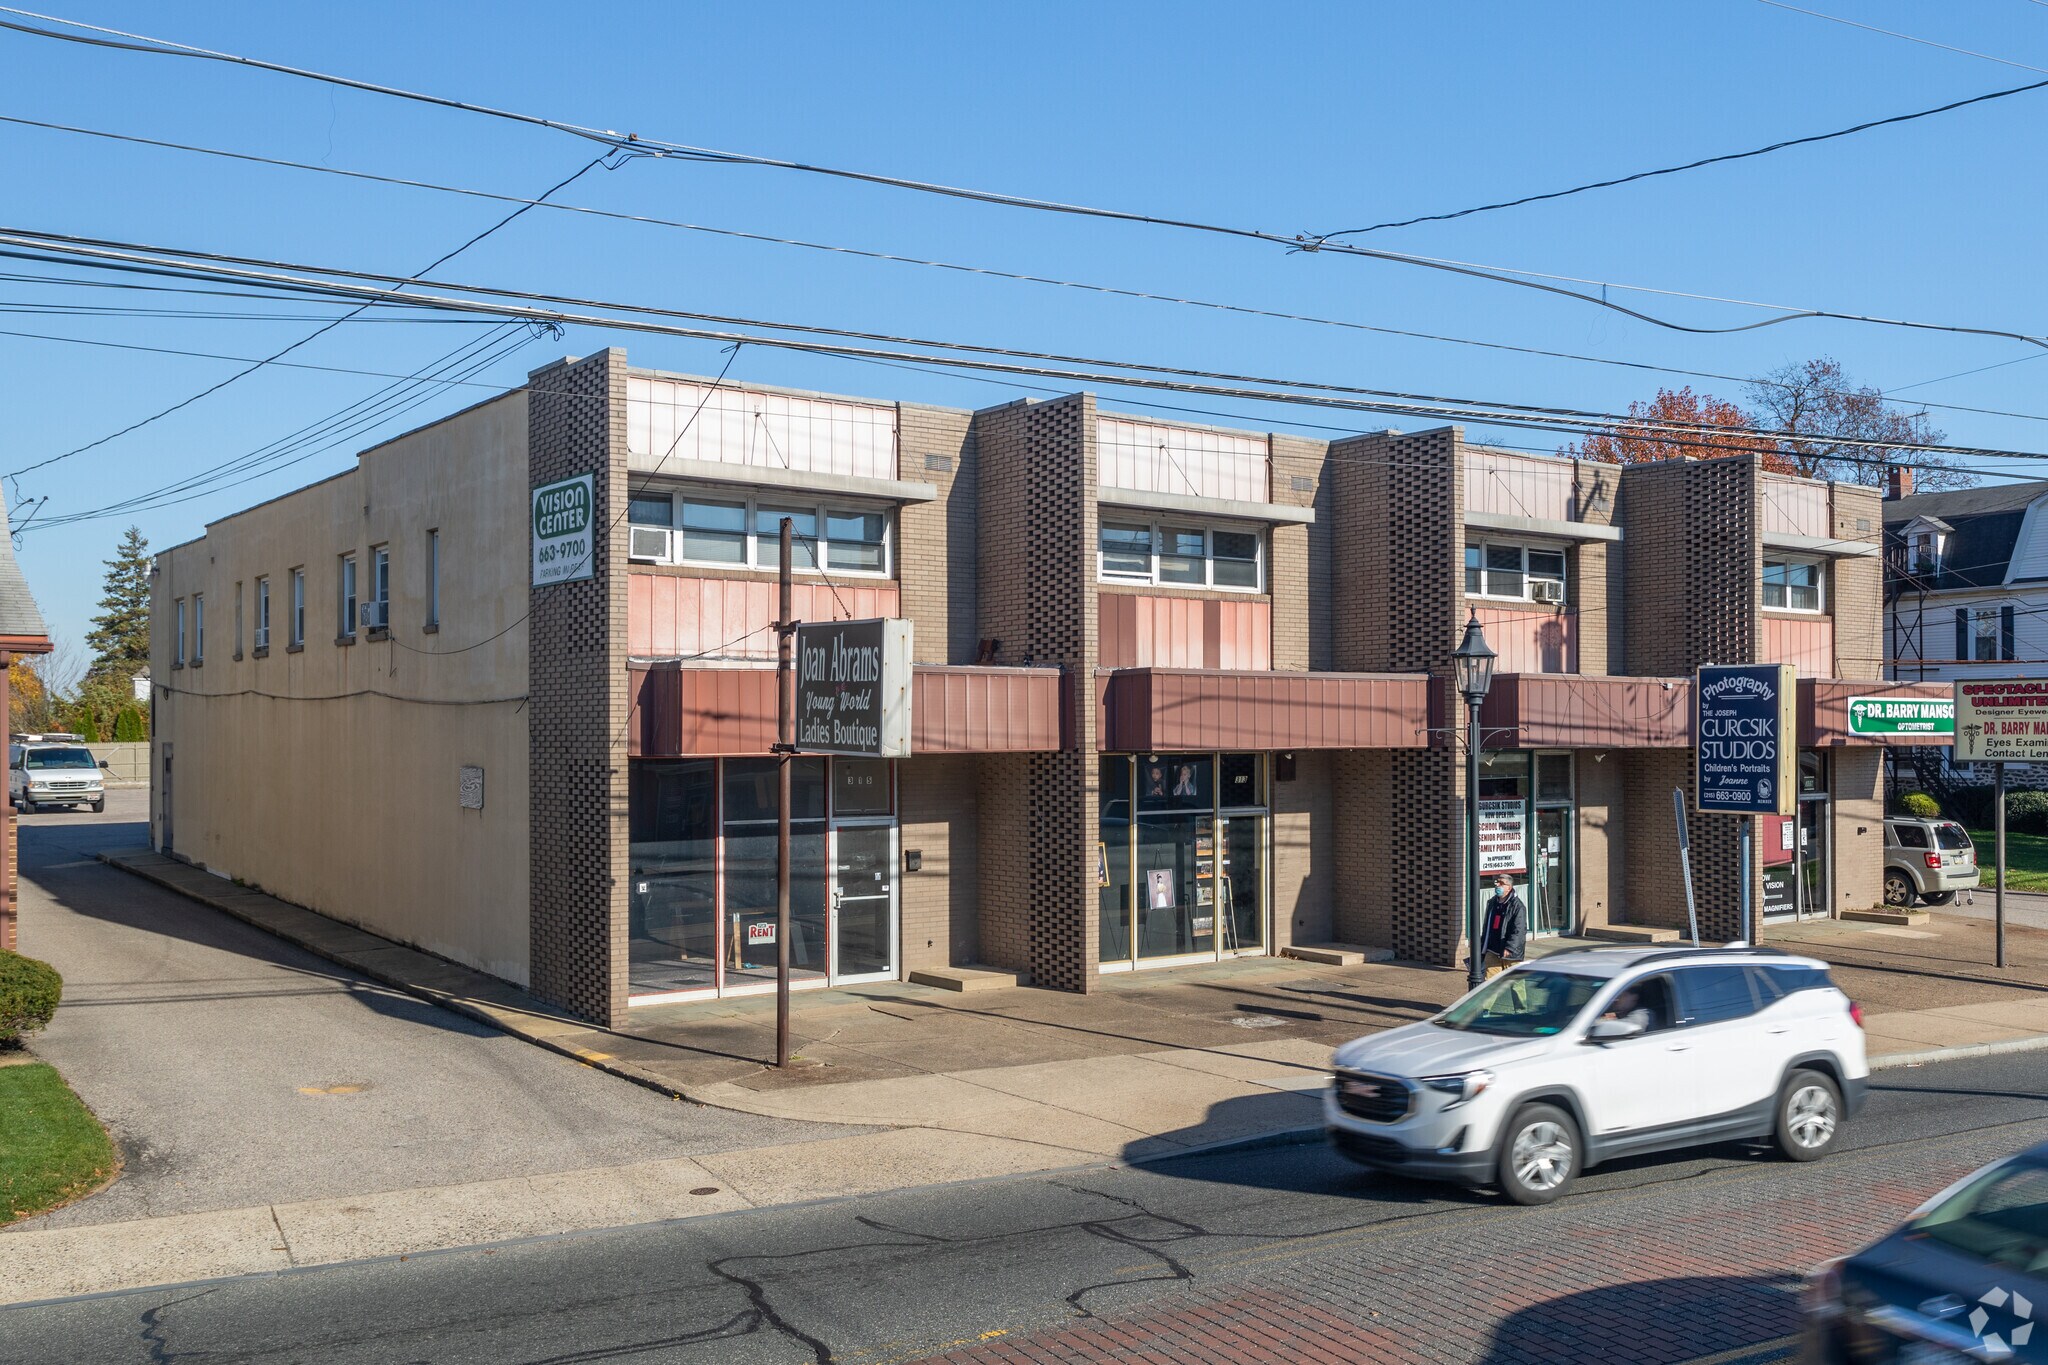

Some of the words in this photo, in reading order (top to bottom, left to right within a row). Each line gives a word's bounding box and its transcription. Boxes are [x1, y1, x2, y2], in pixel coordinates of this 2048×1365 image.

[540, 486, 584, 514] VISION
[539, 507, 585, 536] CENTER
[539, 538, 586, 564] 663-9700
[800, 635, 826, 689] Joan
[829, 631, 879, 682] Abrams
[1702, 676, 1775, 701] Photography
[806, 691, 835, 720] Young
[840, 688, 872, 711] World
[1971, 696, 2048, 707] UNLIMITE
[1867, 703, 1885, 718] DR.
[1886, 703, 1919, 718] BARRY
[1701, 718, 1774, 737] GURCSIK
[1897, 722, 1935, 731] OPTOMETRIST
[1984, 721, 1998, 735] DR.
[2001, 721, 2030, 735] BARRY
[800, 717, 830, 743] Ladies
[834, 718, 877, 751] Boutique
[1986, 738, 2011, 748] Eyes
[2016, 738, 2048, 747] Exami
[1701, 740, 1776, 760] STUDIOS
[1985, 749, 2025, 757] Contact
[1704, 763, 1738, 773] Children's
[1740, 764, 1771, 773] Portraits
[1704, 775, 1711, 783] by
[1719, 774, 1749, 786] Joanne
[1715, 790, 1752, 801] 663-0900
[1501, 801, 1521, 810] STUDIOS
[1499, 822, 1521, 830] PICTURES
[1496, 832, 1522, 841] PORTRAITS
[1496, 843, 1522, 852] PORTRAITS
[1763, 903, 1793, 912] MAGNIFIERS
[750, 925, 775, 938] RENT
